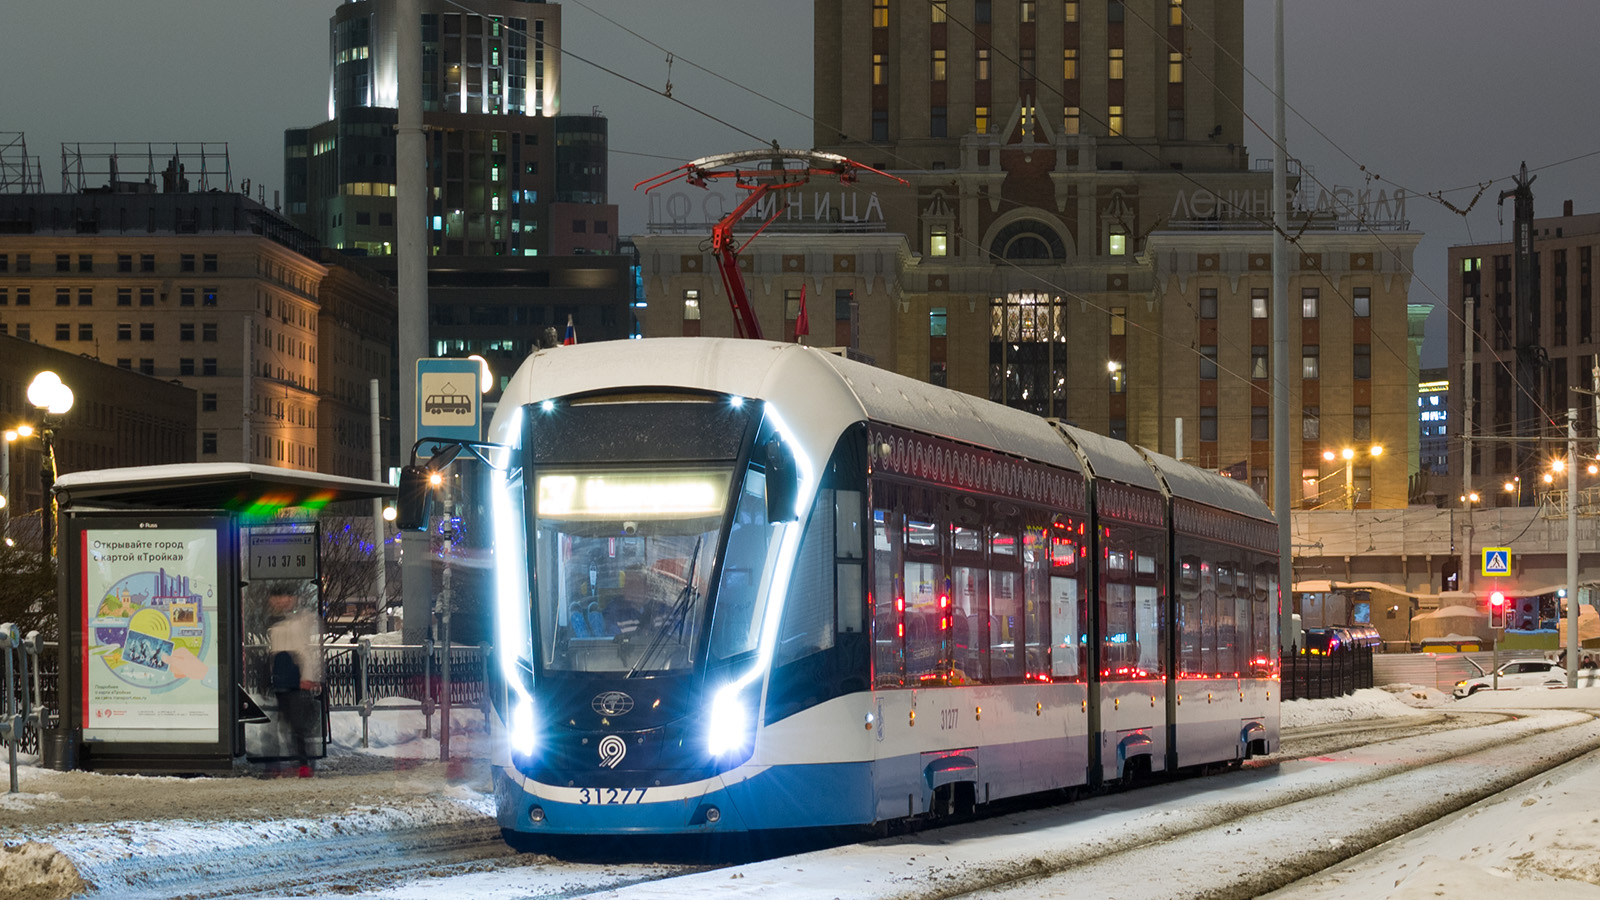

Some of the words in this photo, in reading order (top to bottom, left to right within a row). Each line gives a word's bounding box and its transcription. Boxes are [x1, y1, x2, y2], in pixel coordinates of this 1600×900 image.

[93, 540, 152, 550] Открывайте
[154, 542, 184, 551] город
[101, 552, 135, 563] картой
[137, 552, 184, 563] «Тройка»
[257, 555, 262, 568] 7
[267, 555, 277, 568] 13
[281, 555, 291, 567] 37
[940, 708, 959, 731] 31277
[578, 787, 648, 805] 31277
